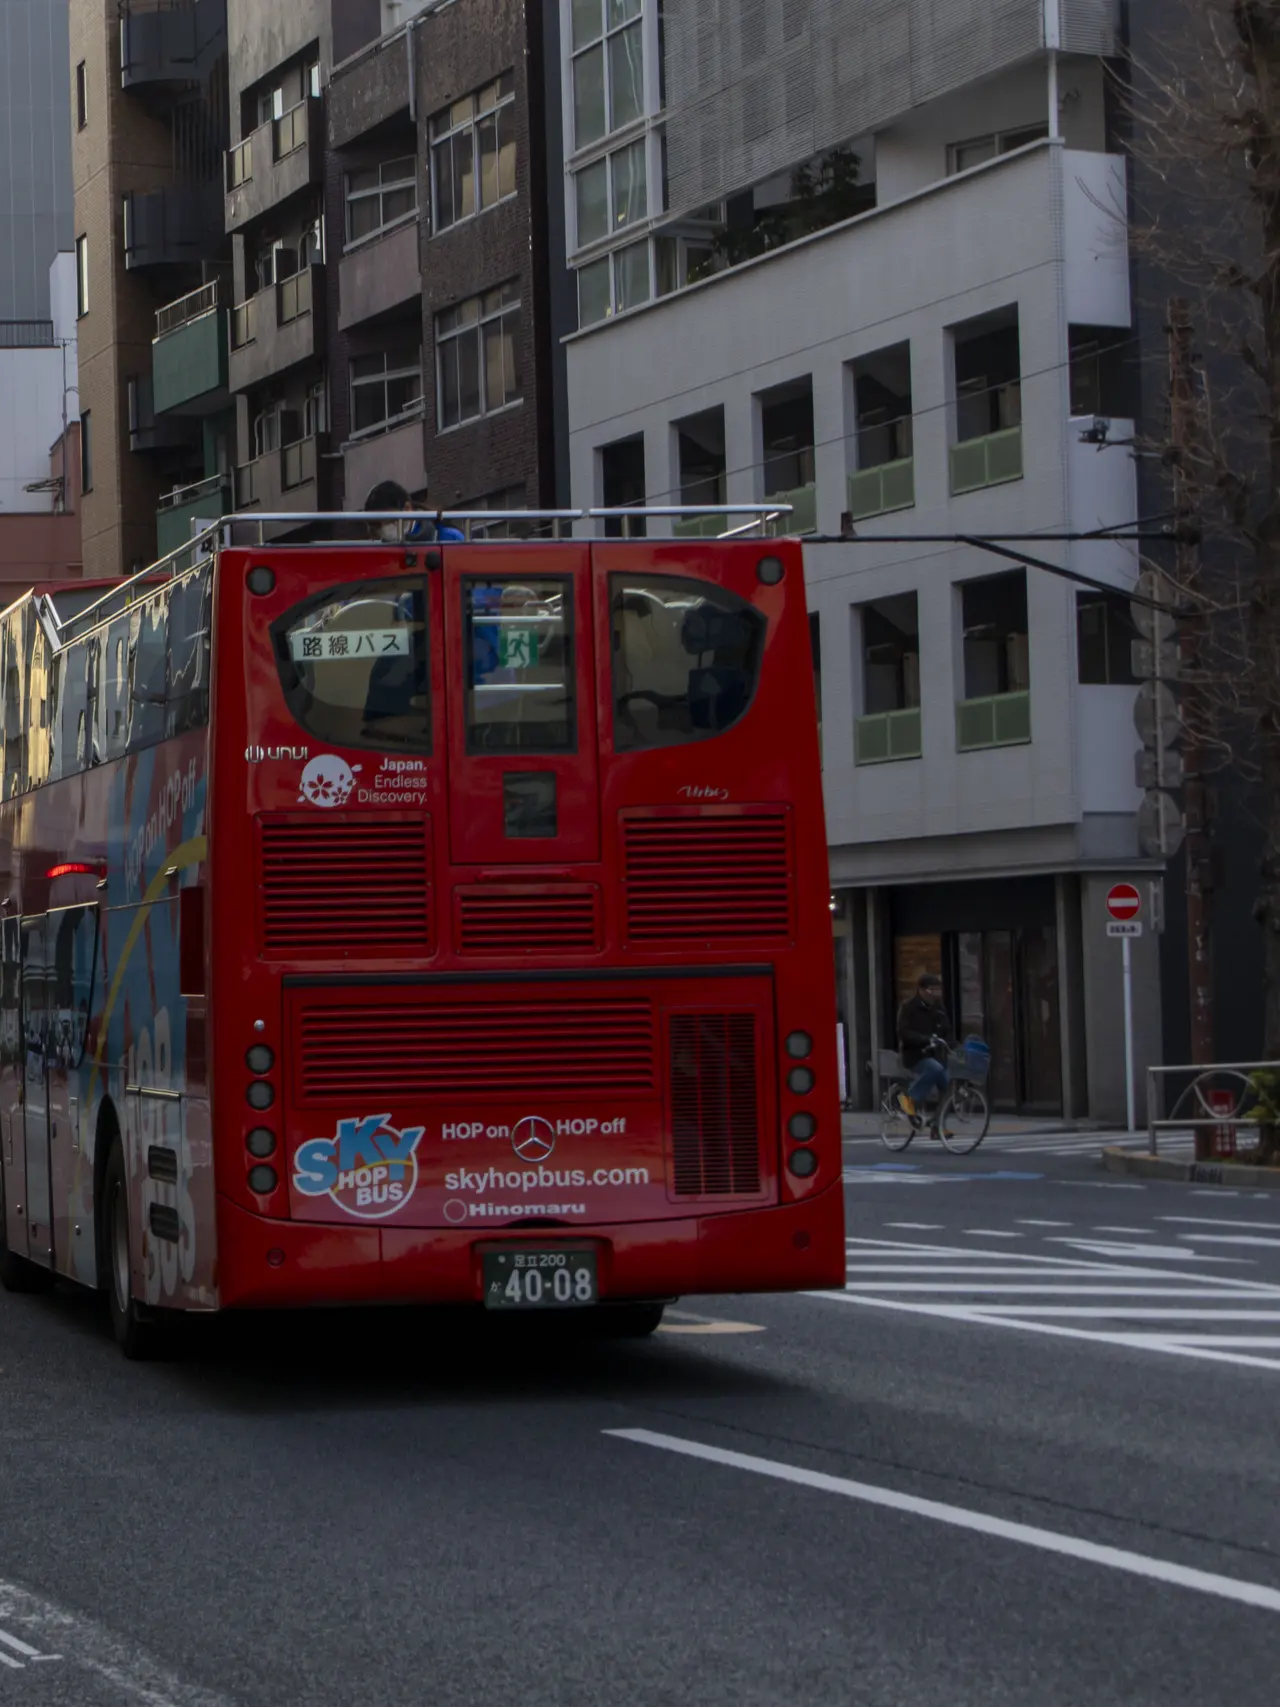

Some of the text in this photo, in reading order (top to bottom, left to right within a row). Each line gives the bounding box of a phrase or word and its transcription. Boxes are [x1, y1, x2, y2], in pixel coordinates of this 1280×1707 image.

[302, 632, 400, 658] 路線バス
[379, 758, 427, 773] Japan.
[374, 775, 427, 788] Endless
[158, 770, 181, 839] HOP
[357, 788, 427, 804] Discovery.
[442, 1117, 626, 1140] HOP on HOP off
[338, 1167, 388, 1190] HOP
[444, 1165, 649, 1194] skyhopbus.com
[356, 1182, 404, 1206] BUS
[468, 1201, 586, 1217] Hinomaru
[504, 1267, 592, 1303] 40-08
